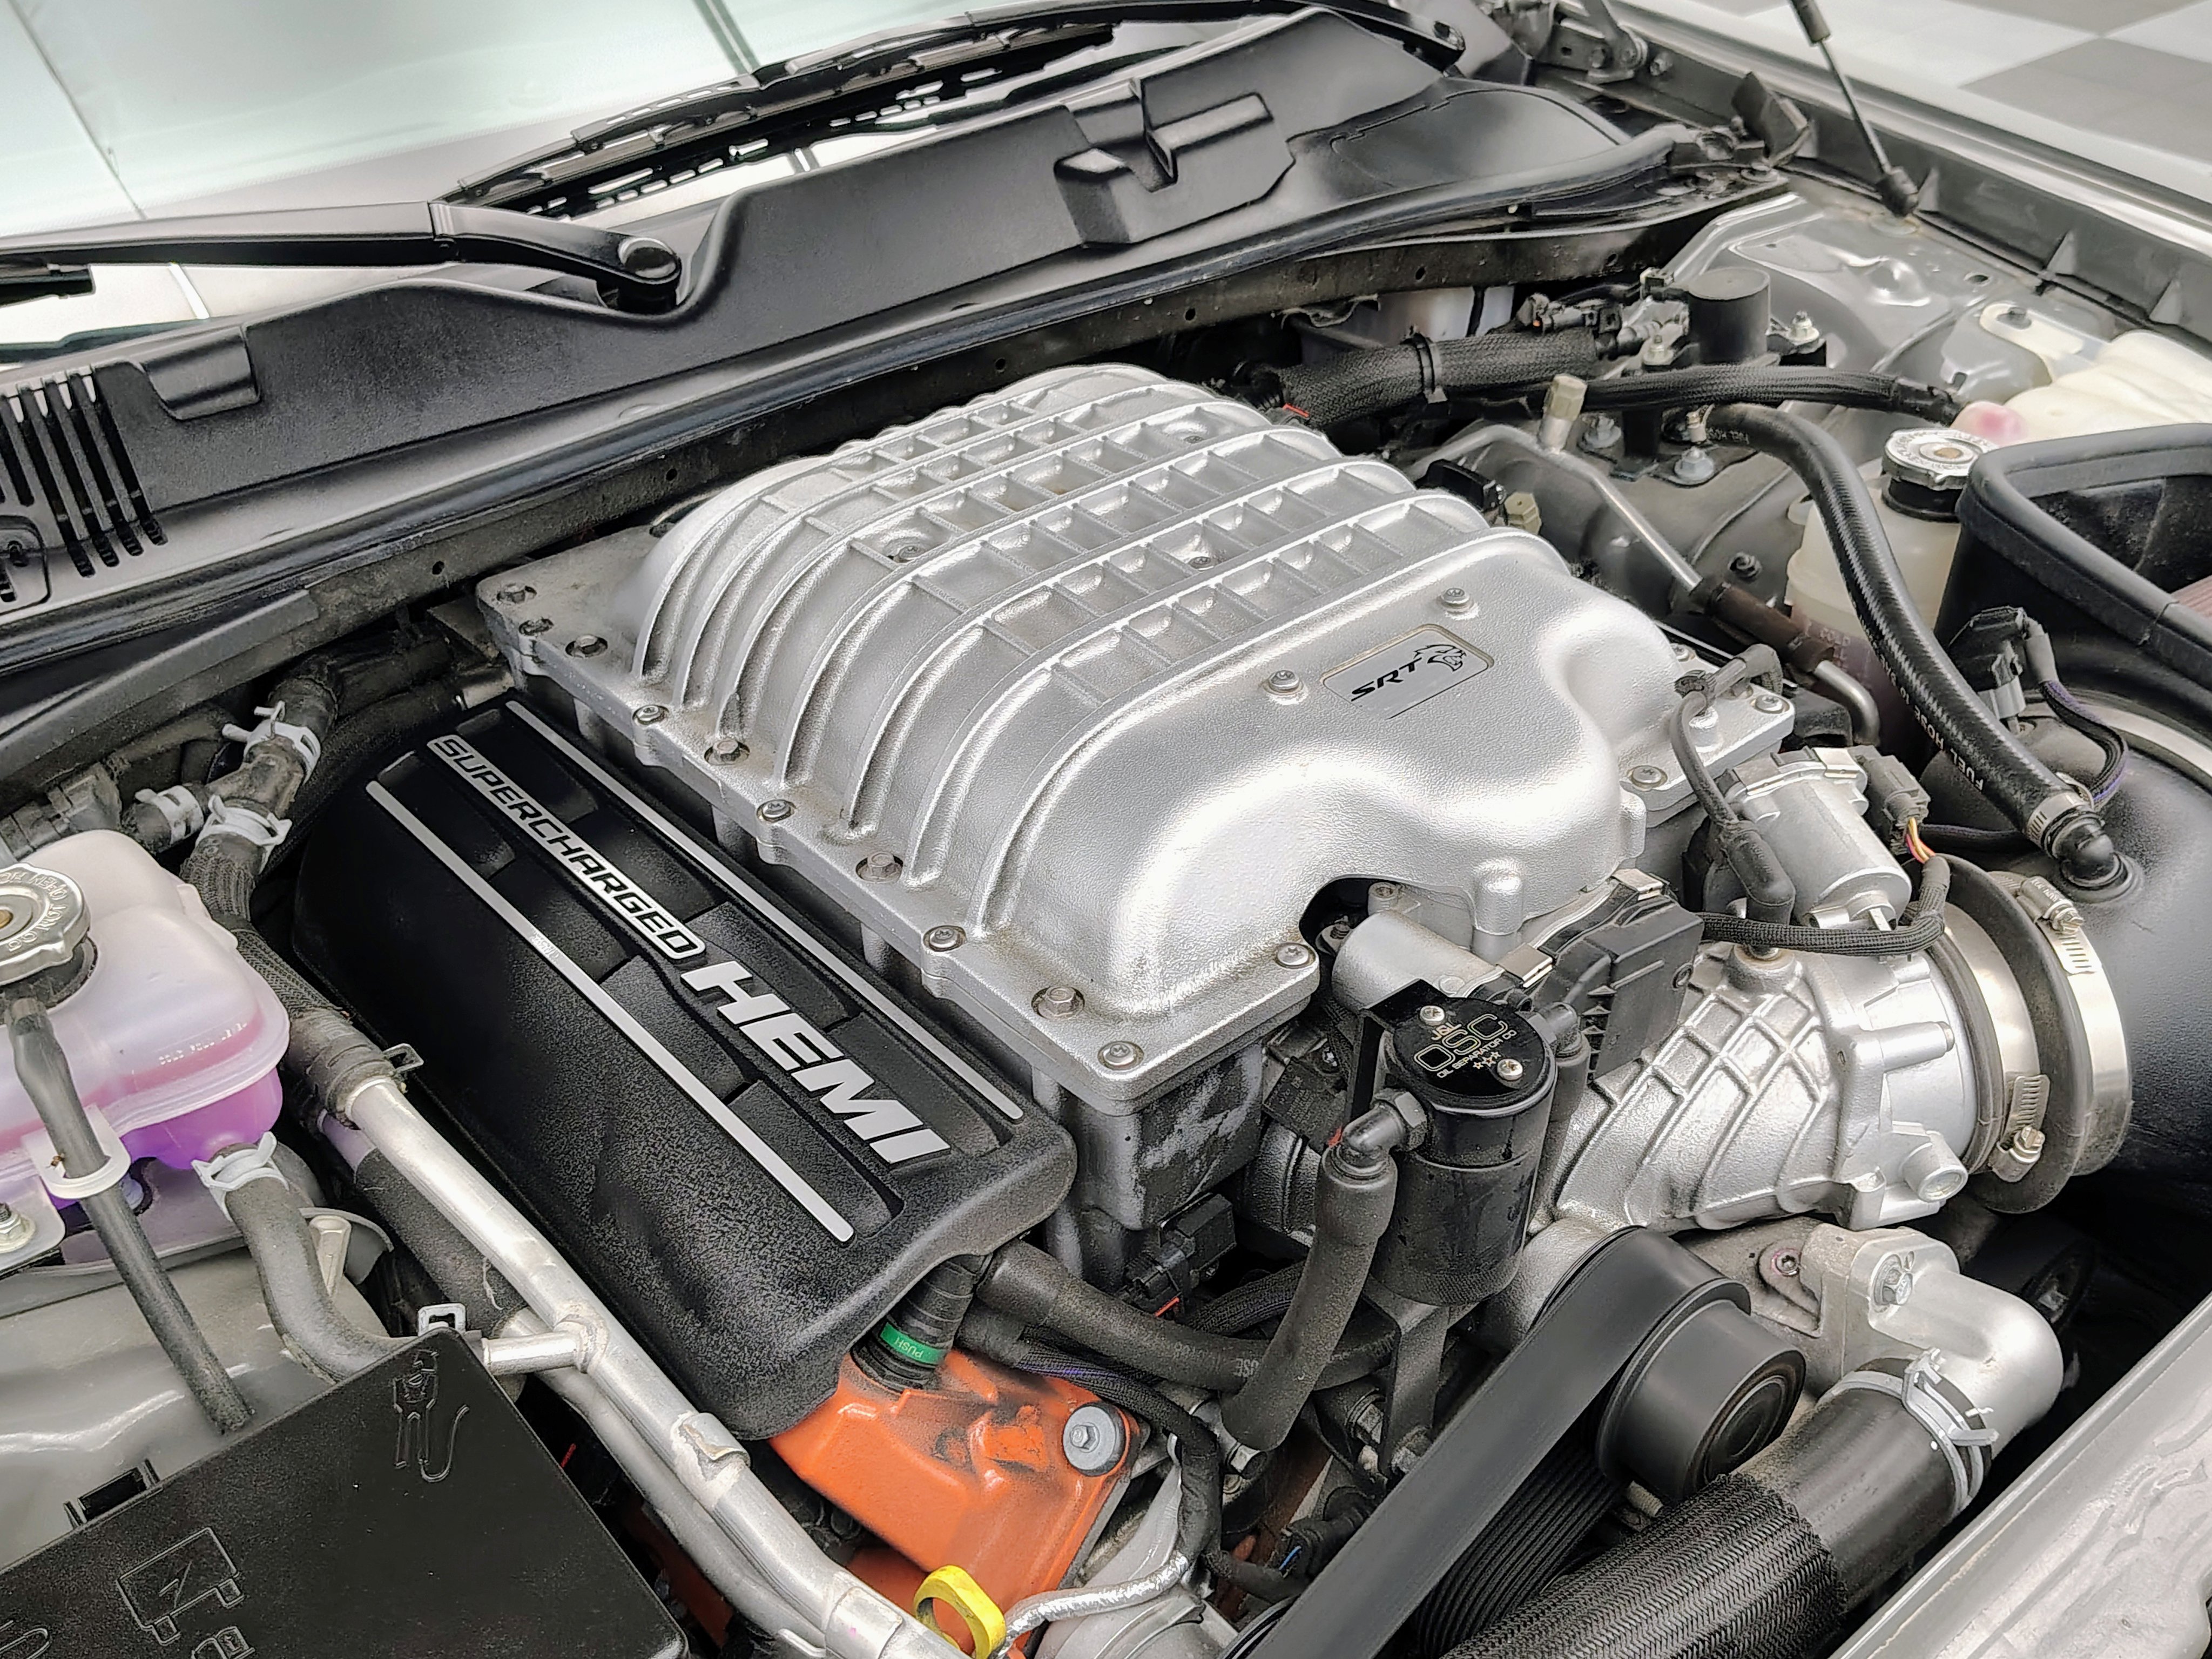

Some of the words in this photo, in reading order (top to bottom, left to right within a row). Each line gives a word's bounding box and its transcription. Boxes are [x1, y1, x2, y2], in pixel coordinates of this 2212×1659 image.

[1351, 657, 1422, 702] SRT
[1914, 705, 1944, 750] HOSE
[1951, 748, 1984, 792] FUEL
[437, 738, 699, 953] SUPERCHARGED
[29, 873, 69, 900] OPEN
[36, 903, 66, 931] NOT
[8, 930, 38, 952] DO
[1414, 1013, 1508, 1071] OSC
[1431, 1022, 1462, 1040] J&L
[680, 961, 950, 1164] HEMI
[1437, 1068, 1454, 1078] OIL
[1452, 1038, 1503, 1070] SEPARATOR
[1502, 1029, 1517, 1040] CO
[894, 1337, 924, 1358] PUSH
